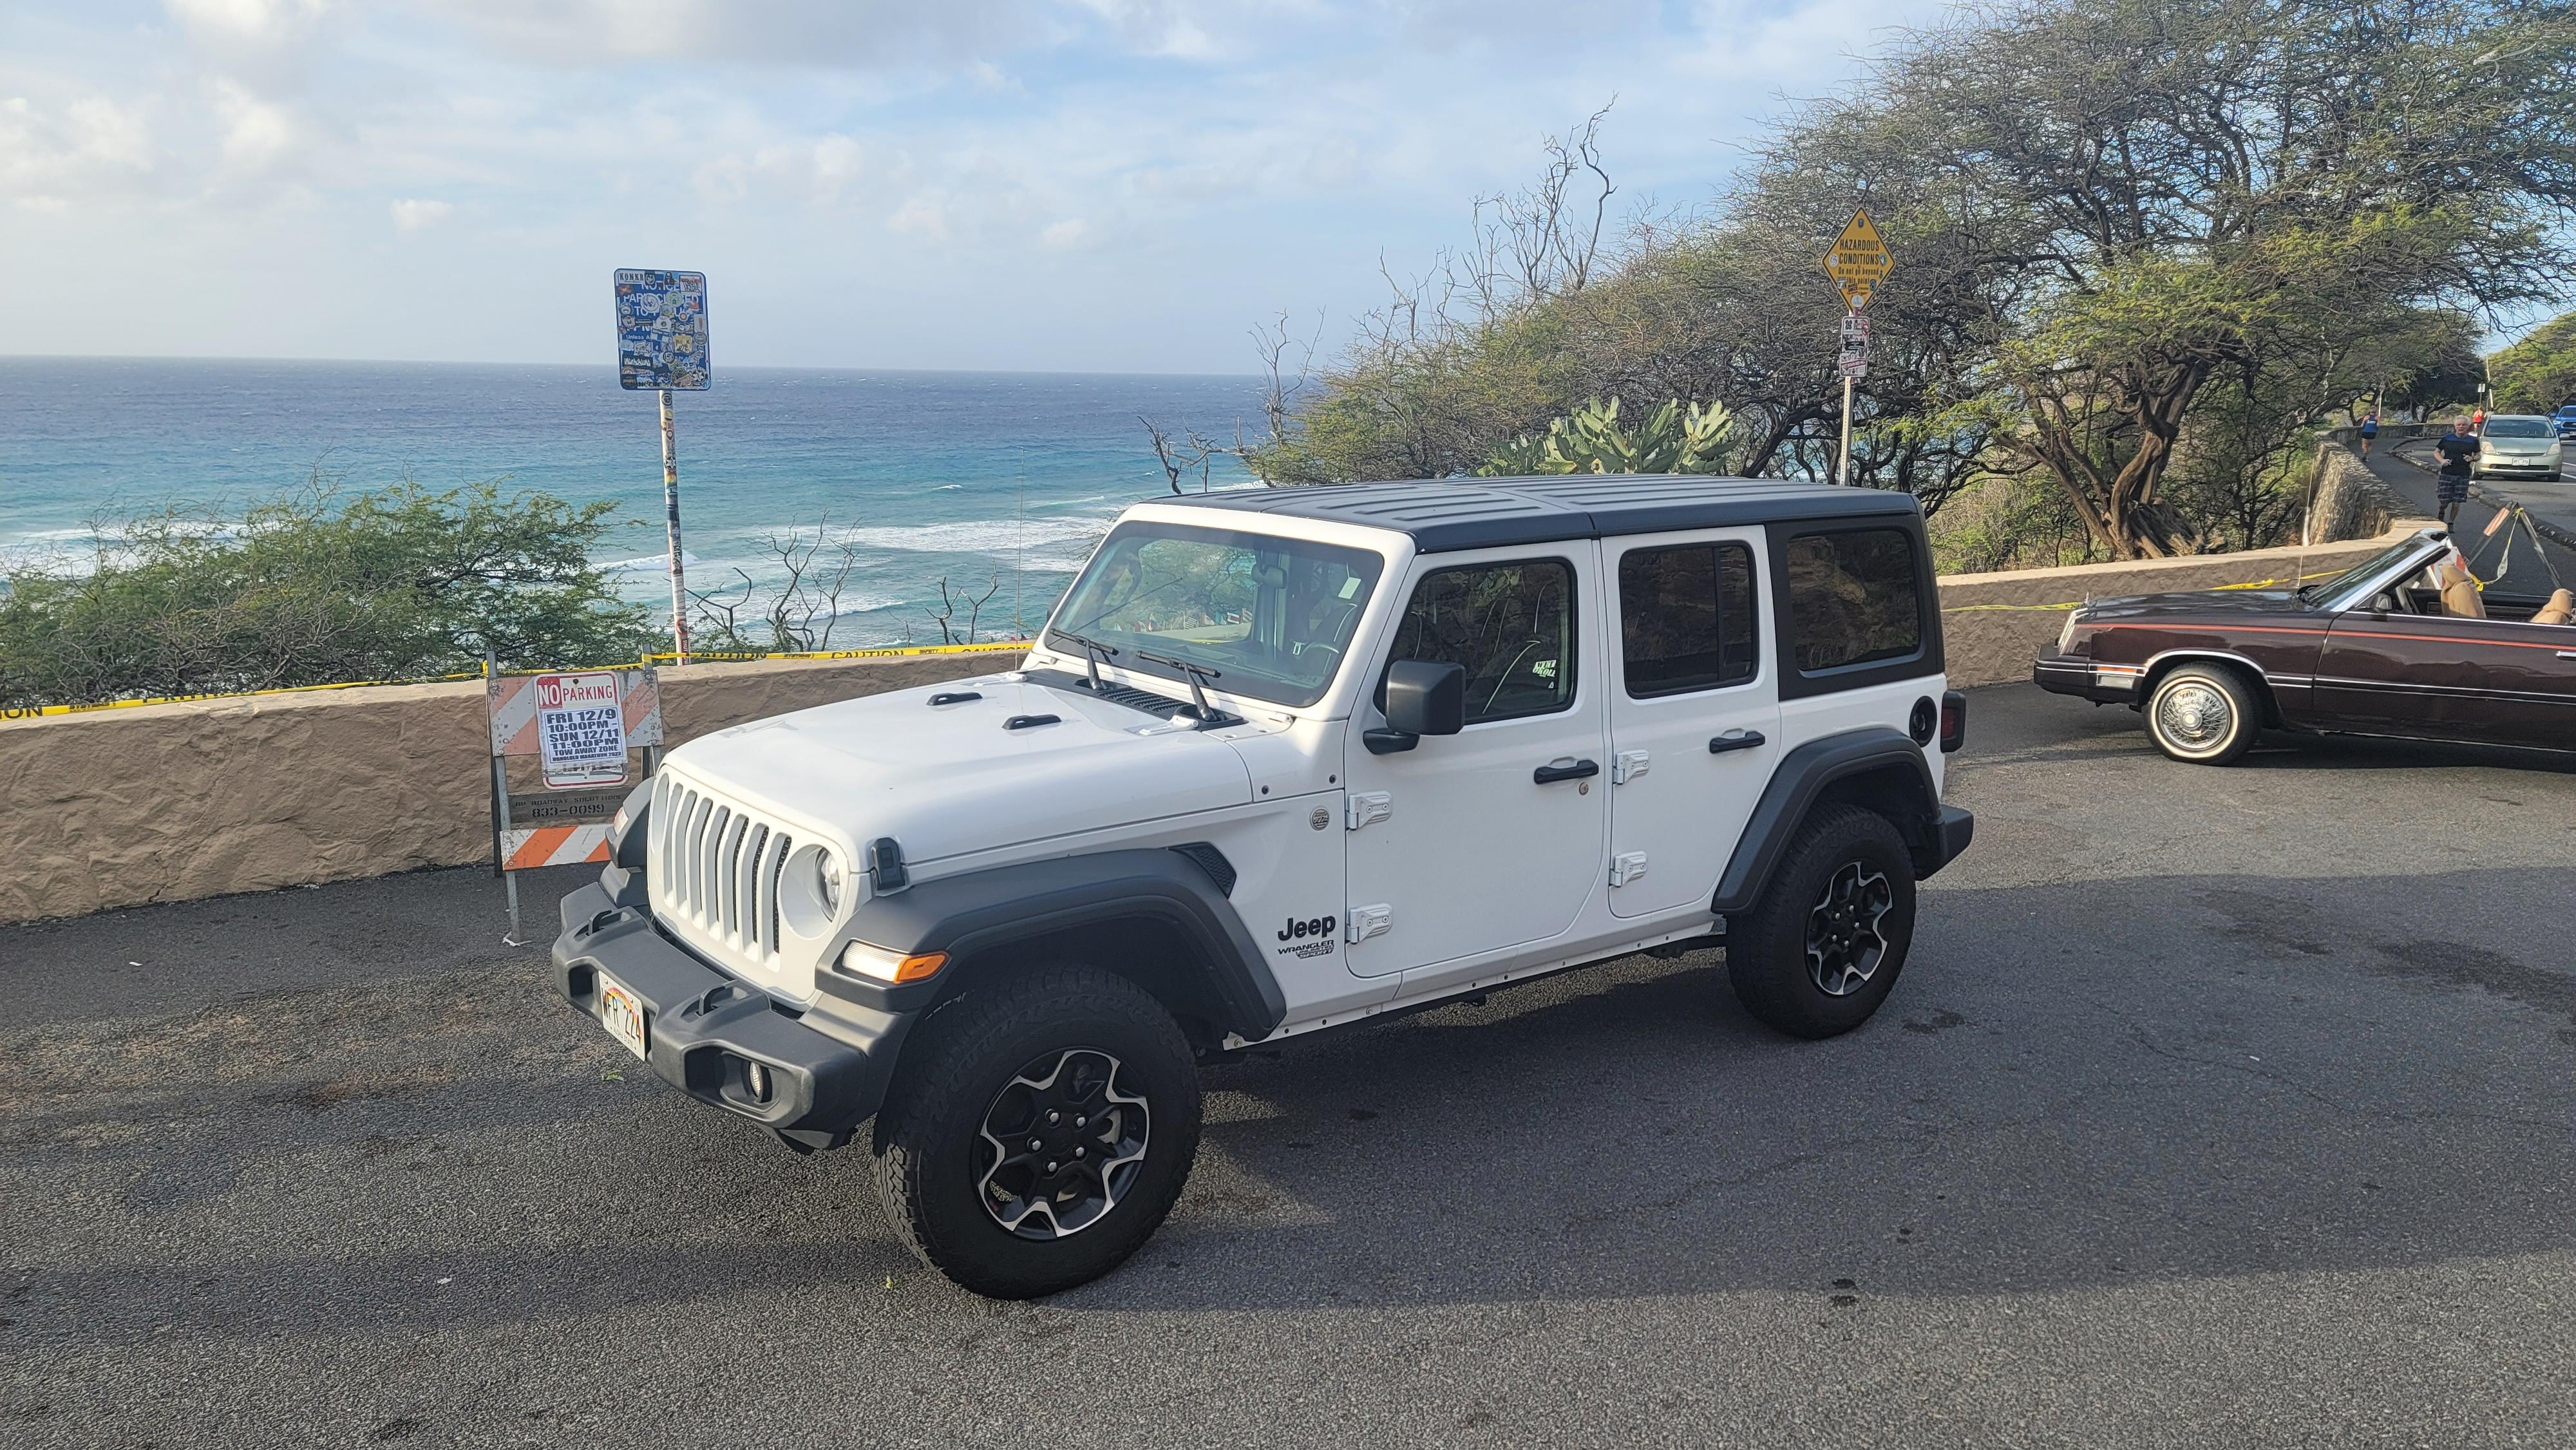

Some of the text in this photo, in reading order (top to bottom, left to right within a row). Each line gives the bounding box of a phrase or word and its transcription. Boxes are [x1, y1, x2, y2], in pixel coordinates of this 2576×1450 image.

[1840, 239, 1879, 251] HAZARDOUS
[1839, 252, 1879, 265] CONDITIONS
[1855, 267, 1861, 276] go
[1862, 267, 1879, 276] beyond
[831, 650, 904, 659] CAUTION
[538, 684, 613, 705] NO PARKING
[546, 708, 616, 724] FRI 12/9
[547, 720, 609, 733] 10:00PM
[549, 729, 620, 743] SUN 12/11
[550, 738, 619, 749] 11:00PM
[574, 795, 621, 803] SOLUTIONS
[532, 804, 605, 818] 833-0099
[1278, 916, 1336, 941] Jeep
[1278, 939, 1335, 955] WRANGLER
[623, 1004, 641, 1046] 224
